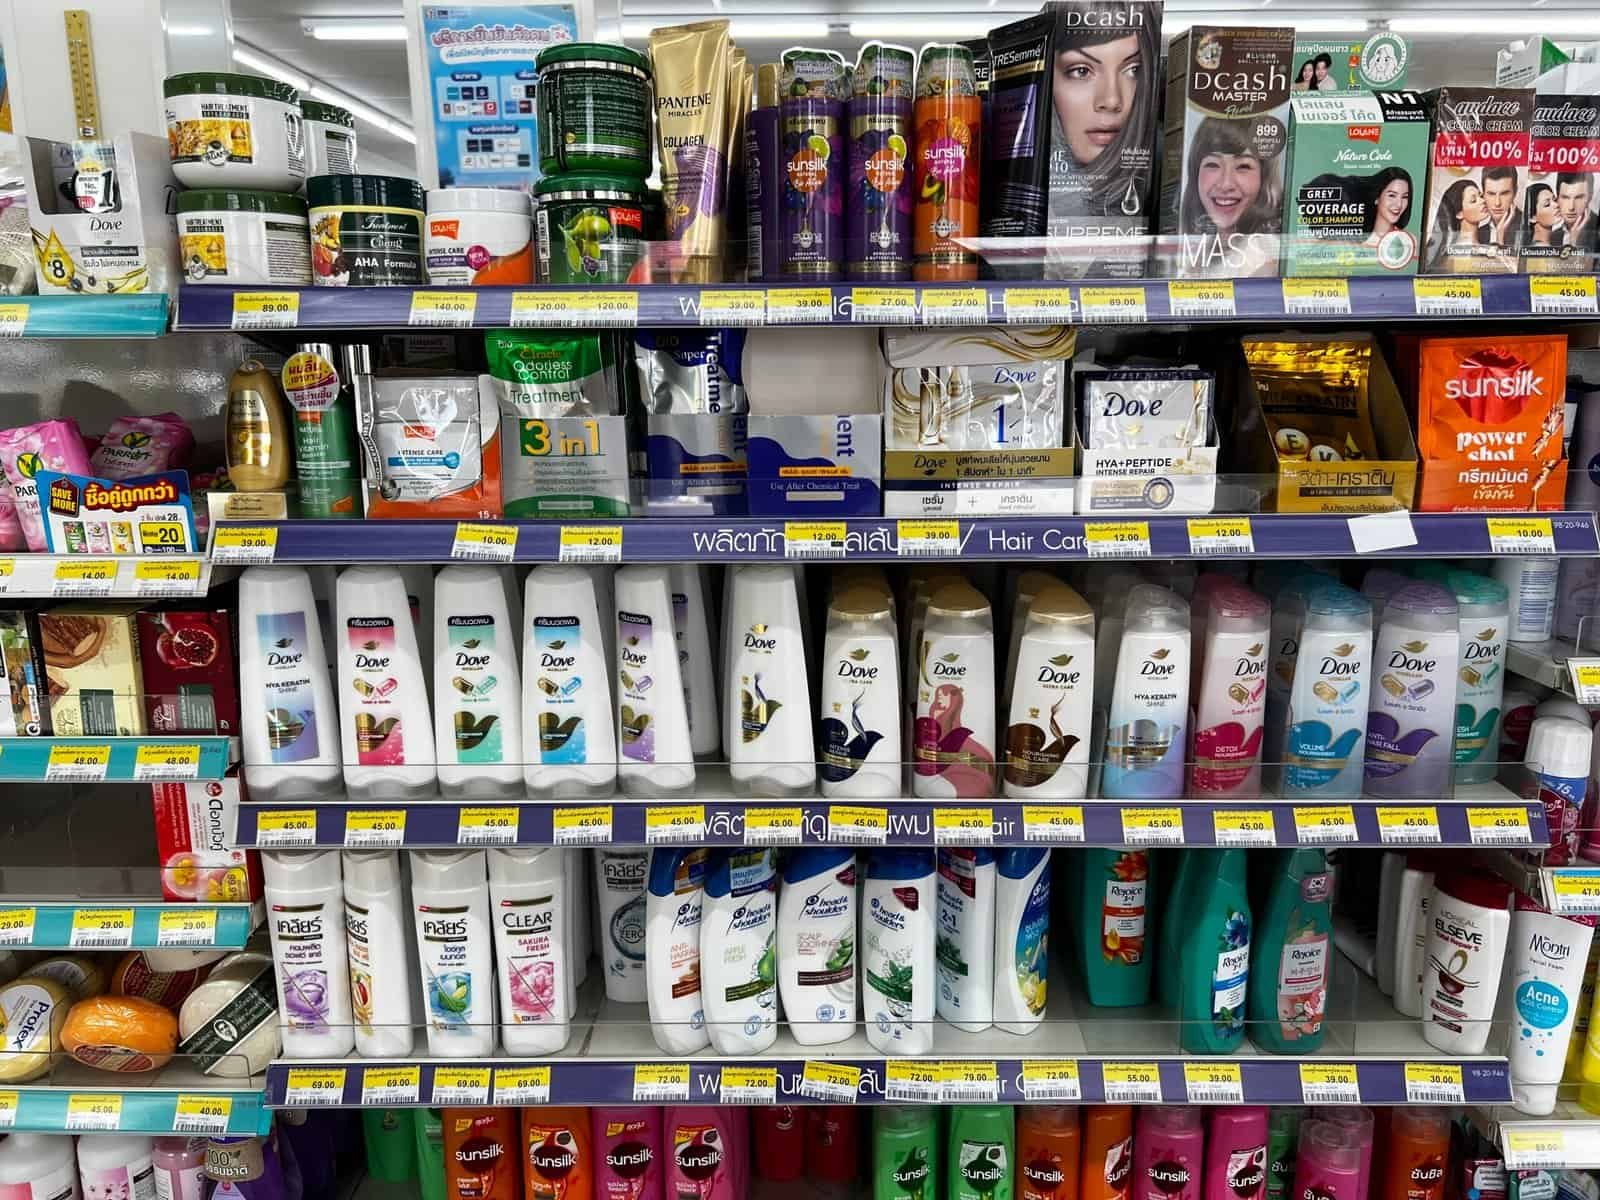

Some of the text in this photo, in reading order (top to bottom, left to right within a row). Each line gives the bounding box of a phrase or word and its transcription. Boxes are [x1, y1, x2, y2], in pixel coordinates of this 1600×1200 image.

[658, 92, 711, 107] PANTENE
[1212, 92, 1267, 102] MASTER
[668, 110, 702, 118] MIRACLES
[1256, 124, 1278, 137] 899
[1486, 120, 1524, 132] CREAM
[1350, 127, 1380, 137] LOLANE
[664, 134, 704, 148] COLLAGEN
[924, 147, 967, 161] sunsilk
[1334, 149, 1392, 162] Nature Code
[1470, 141, 1521, 160] 100%
[1550, 148, 1599, 166] 100%
[787, 158, 828, 173] sunsilk
[864, 158, 905, 172] sunsilk
[1308, 190, 1334, 198] GREY
[1298, 203, 1364, 216] COVERAGE
[89, 217, 122, 232] Dove
[1297, 216, 1364, 224] COLOR SHAMPOO
[354, 258, 378, 268] AHA
[384, 258, 416, 270] Formula
[1312, 290, 1339, 298] 79.00
[1444, 290, 1472, 298] 45.00
[1560, 289, 1586, 297] 45.00
[262, 302, 289, 312] 89.00
[598, 302, 628, 310] 120.00
[796, 300, 822, 308] 39.00
[880, 298, 907, 306] 27.00
[434, 303, 466, 312] 140.00
[513, 360, 573, 372] Odorless
[518, 370, 570, 380] Control
[994, 366, 1036, 384] Dove
[1445, 370, 1544, 399] sunsilk
[510, 390, 584, 404] Treatment
[1103, 392, 1162, 417] Dove
[524, 420, 599, 456] 3 in 1
[1286, 434, 1298, 450] E
[1456, 432, 1527, 452] power
[102, 447, 152, 460] PARROT
[1467, 446, 1515, 461] shot
[914, 454, 946, 469] Dove
[1096, 458, 1172, 468] HYA+PEPTIDE
[1128, 468, 1156, 476] REPAIR
[770, 482, 784, 490] Use
[788, 482, 804, 490] After
[806, 481, 840, 490] Chemical
[52, 487, 74, 499] SAVE
[85, 482, 174, 508] ซื้อคู่ถูกกว่า
[52, 499, 77, 512] MORE
[167, 512, 178, 522] 28
[160, 528, 179, 544] 20
[812, 532, 838, 540] 12.00
[925, 532, 950, 540] 39.00
[1216, 528, 1241, 536] 12.00
[1518, 530, 1543, 538] 10.00
[482, 536, 507, 544] 10.00
[588, 538, 612, 546] 12.00
[988, 529, 1033, 552] Hair
[1114, 534, 1140, 542] 12.00
[240, 539, 266, 548] 39.00
[82, 572, 106, 580] 14.00
[166, 572, 190, 580] 14.00
[744, 633, 776, 649] Dove
[622, 648, 647, 664] Dove
[1464, 642, 1500, 660] Dove
[268, 652, 302, 666] Dove
[356, 654, 390, 668] Dove
[455, 652, 490, 667] Dove
[541, 654, 575, 668] Dove
[1388, 652, 1436, 672] Dove
[838, 660, 878, 678] Dove
[934, 662, 966, 676] Dove
[1140, 660, 1175, 676] Dove
[1235, 658, 1266, 676] Dove
[1320, 657, 1360, 676] Dove
[1038, 666, 1080, 684] Dove
[74, 758, 98, 766] 48.00
[166, 757, 190, 765] 48.00
[284, 822, 308, 830] 45.00
[372, 822, 396, 830] 45.00
[485, 818, 508, 827] 45.00
[579, 818, 602, 826] 45.00
[671, 816, 695, 826] 45.00
[769, 819, 793, 828] 45.00
[854, 818, 878, 828] 45.00
[960, 819, 984, 828] 45.00
[1050, 818, 1074, 826] 45.00
[1148, 820, 1172, 828] 45.00
[1240, 822, 1264, 830] 45.00
[1320, 818, 1344, 826] 45.00
[1404, 818, 1428, 826] 45.00
[1495, 818, 1520, 827] 45.00
[1111, 886, 1143, 897] Rejoice
[502, 912, 552, 928] CLEAR
[0, 921, 24, 930] 29.00
[100, 921, 124, 930] 29.00
[183, 921, 206, 930] 29.00
[278, 917, 322, 934] เคลียร์
[424, 918, 468, 936] เคลียร์
[1434, 918, 1482, 944] ELSEVE
[518, 936, 549, 946] SAKURA
[526, 944, 550, 952] FRESH
[1222, 950, 1248, 967] Rejoice
[1291, 948, 1321, 960] Rejoice
[1526, 986, 1560, 1005] Acne
[12, 1000, 50, 1050] Protex
[658, 1076, 681, 1084] 72.00
[826, 1074, 850, 1086] 72.00
[910, 1073, 933, 1082] 72.00
[964, 1073, 987, 1082] 79.00
[1046, 1071, 1069, 1080] 72.00
[1127, 1074, 1150, 1082] 55.00
[1208, 1074, 1232, 1082] 39.00
[1325, 1075, 1348, 1084] 39.00
[1430, 1075, 1454, 1084] 30.00
[312, 1080, 335, 1088] 69.00
[386, 1078, 410, 1087] 69.00
[456, 1080, 480, 1088] 69.00
[518, 1079, 541, 1088] 69.00
[744, 1080, 768, 1088] 72.00
[200, 1106, 222, 1116] 40.00
[456, 1144, 504, 1162] sunsilk
[606, 1150, 654, 1166] sunsilk
[530, 1152, 577, 1168] sunsilk
[674, 1152, 724, 1168] sunsilk
[892, 1165, 932, 1182] sunsilk
[960, 1167, 1003, 1182] sunsilk
[1024, 1166, 1065, 1182] sunsilk
[1147, 1167, 1191, 1182] sunsilk
[1228, 1172, 1266, 1188] sunsilk
